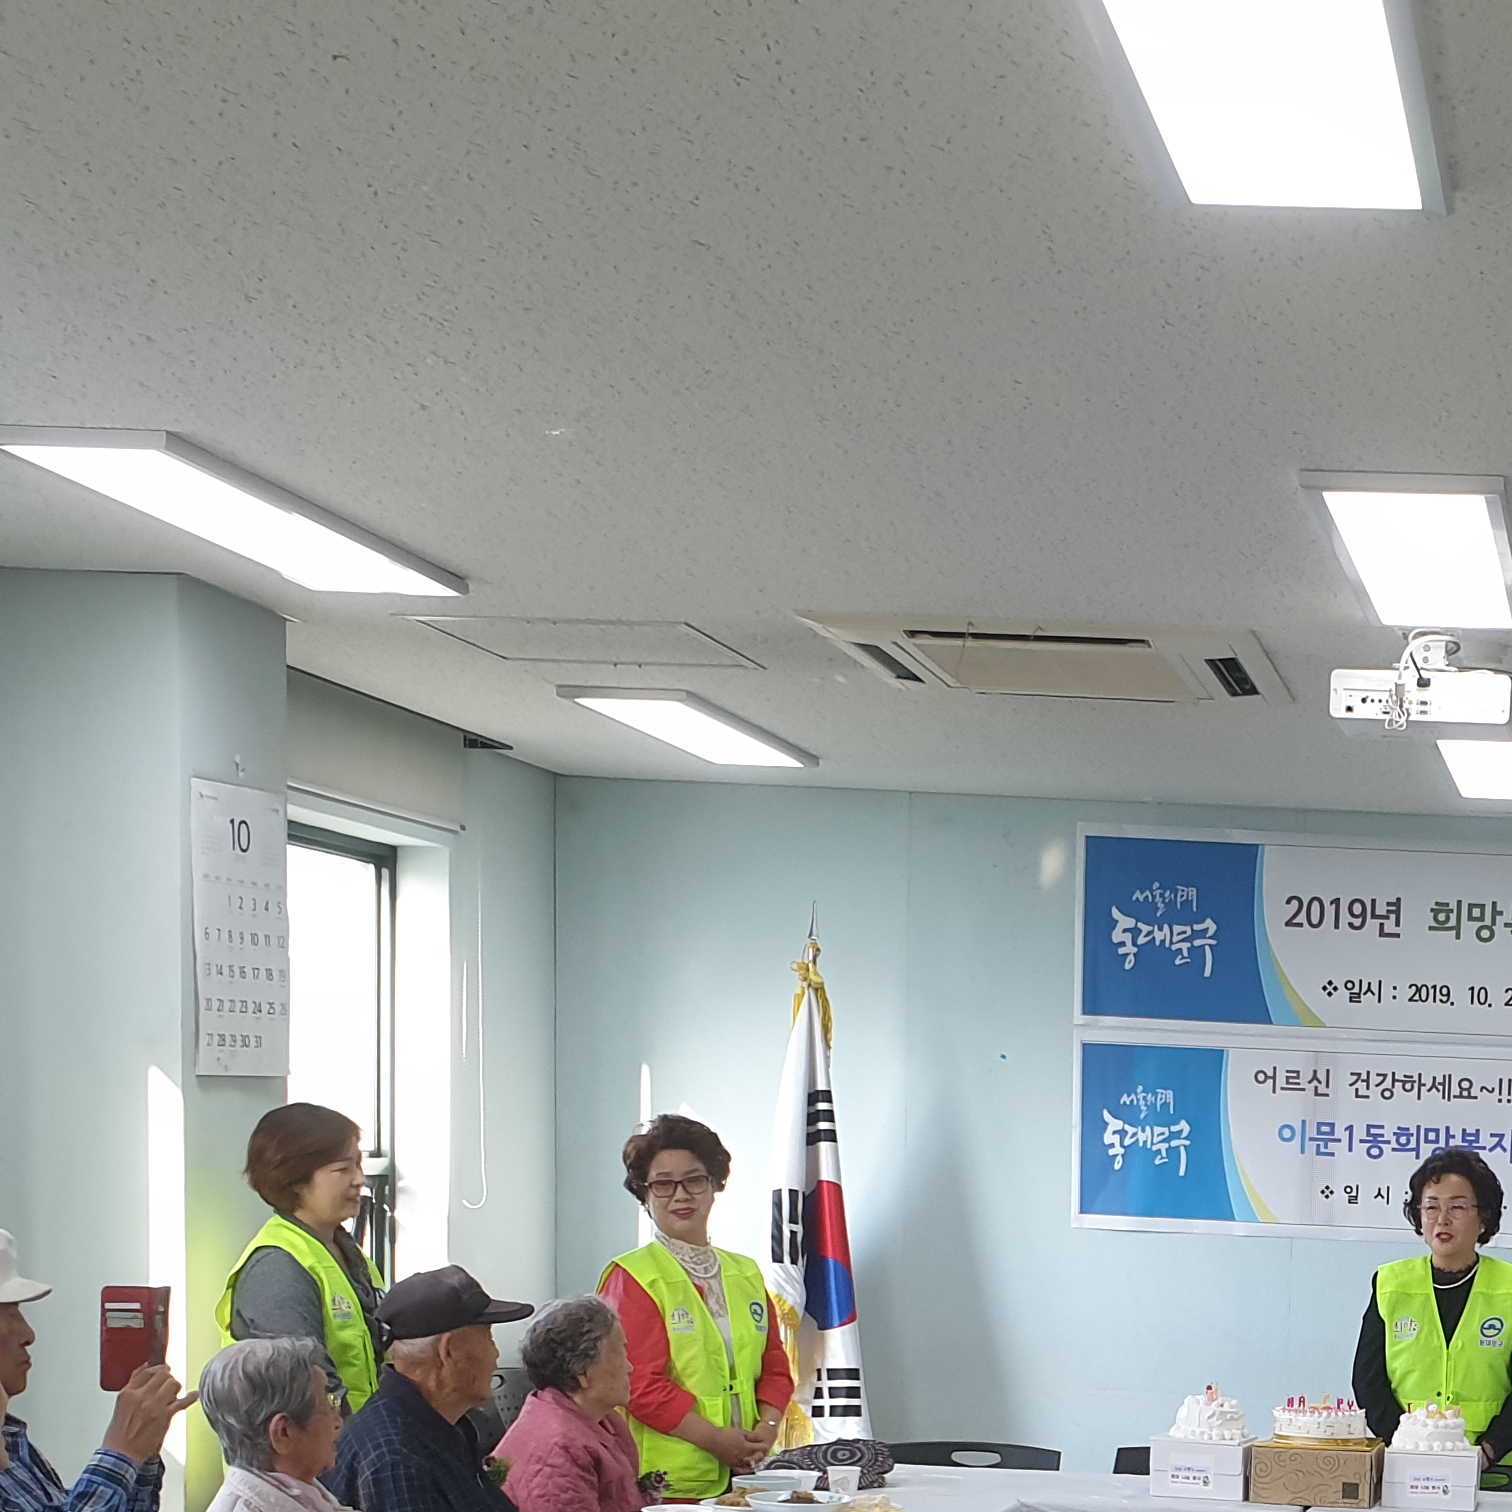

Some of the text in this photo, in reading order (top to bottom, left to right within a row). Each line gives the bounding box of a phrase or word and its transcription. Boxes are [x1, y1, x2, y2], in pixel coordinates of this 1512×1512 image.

[229, 818, 251, 853] 10
[238, 896, 244, 910] 2
[252, 898, 257, 912] 3
[264, 900, 270, 912] 4
[1284, 895, 1402, 939] 2019년
[204, 926, 210, 941] 6
[216, 927, 222, 941] 7
[239, 931, 245, 945] 9
[250, 932, 260, 947] 10
[1111, 905, 1218, 977] 동대문구
[252, 967, 260, 980] 17
[1343, 978, 1383, 1004] 일시
[1407, 983, 1455, 1007] 2019.
[1467, 985, 1493, 1009] 10.
[1253, 1065, 1512, 1104] 어르신 건강하세요~!!
[1103, 1109, 1191, 1177] 동대문구
